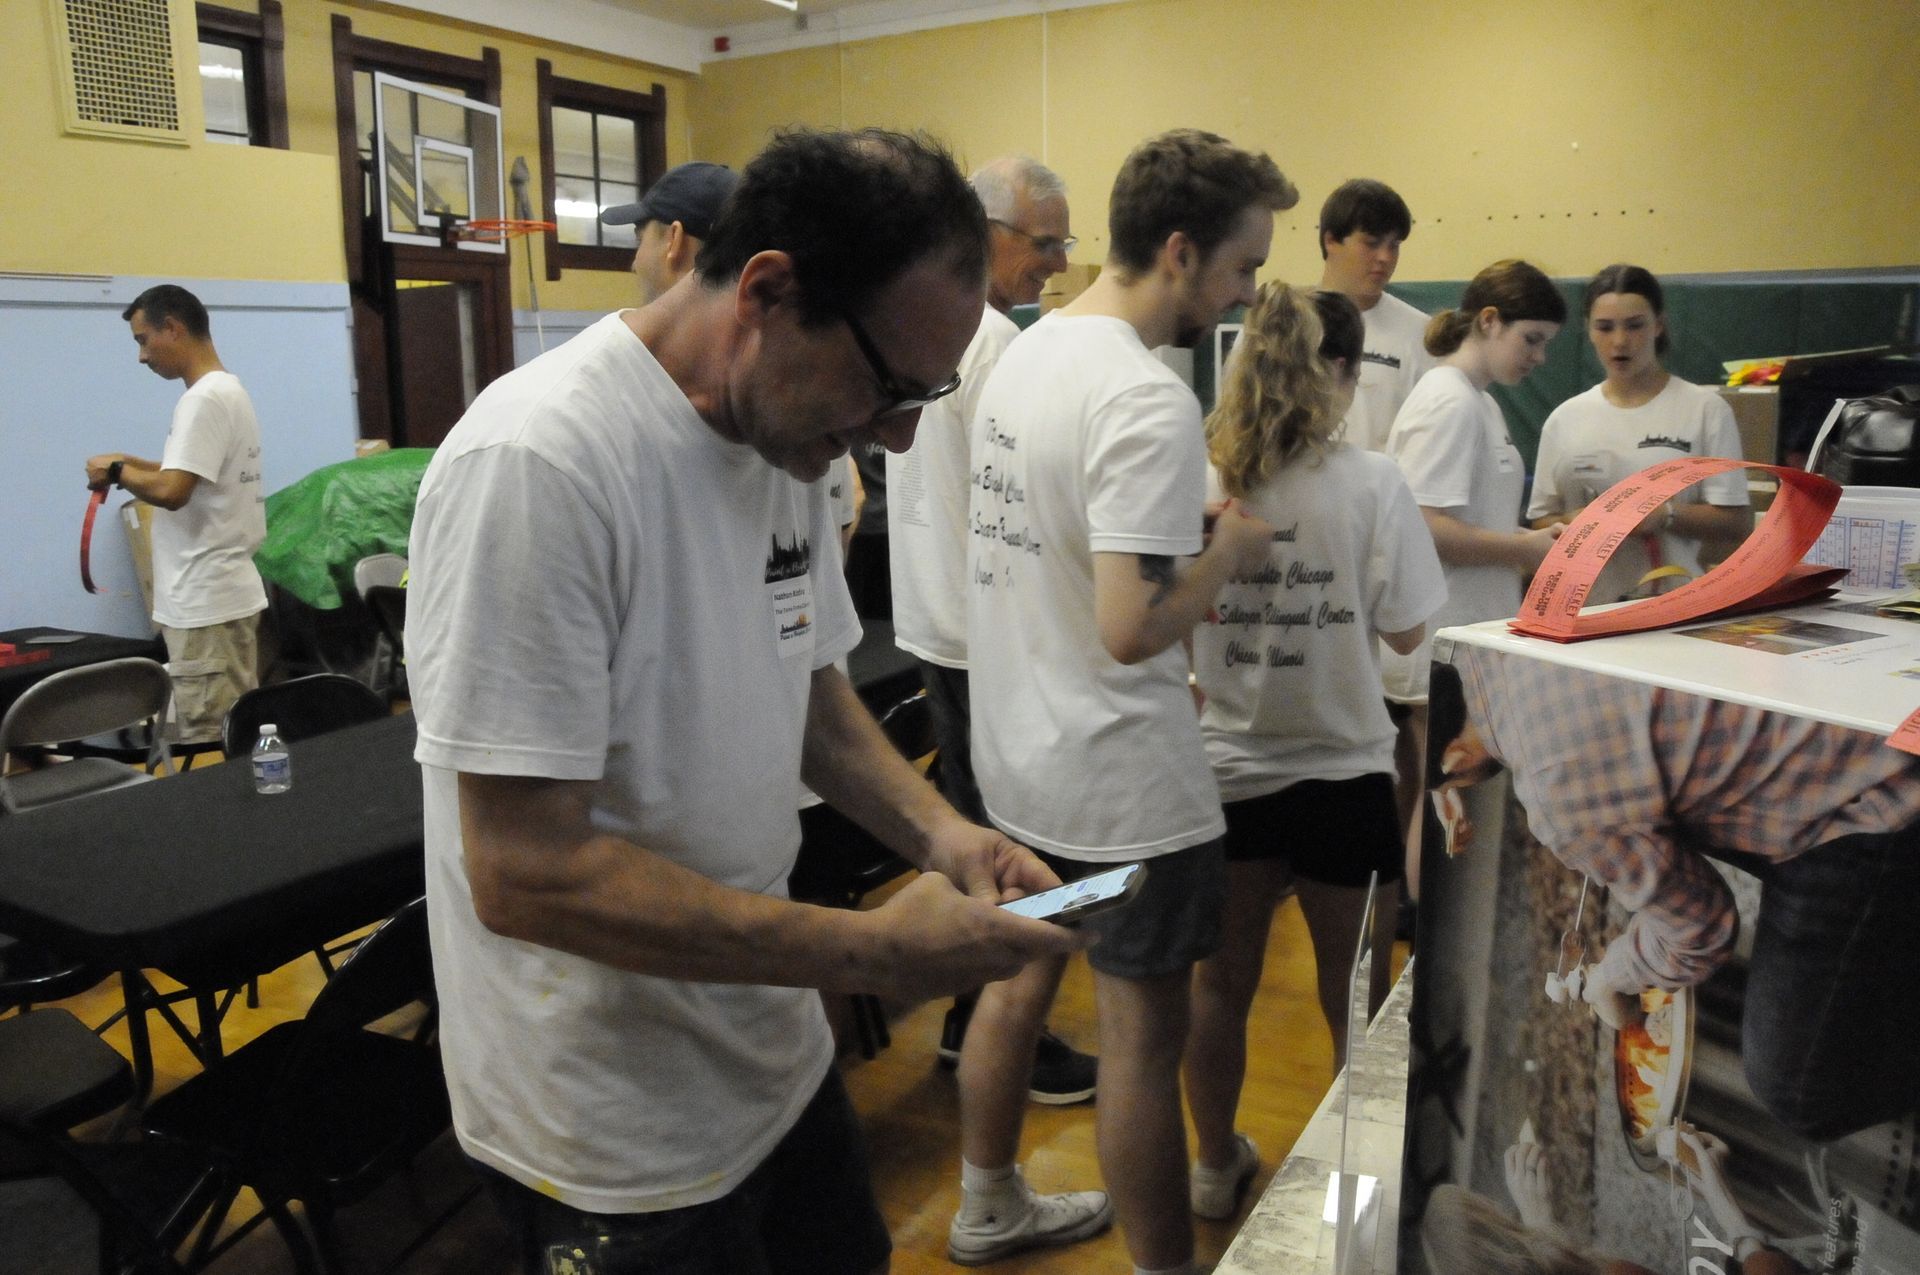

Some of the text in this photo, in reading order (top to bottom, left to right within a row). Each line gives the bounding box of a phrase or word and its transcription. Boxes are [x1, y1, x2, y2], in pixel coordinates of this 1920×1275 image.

[1597, 531, 1625, 560] TICKET
[1286, 561, 1335, 592] Chicago
[1535, 575, 1554, 611] COUPON
[1317, 601, 1355, 630] Center
[1566, 583, 1589, 618] TICKET
[1816, 1197, 1842, 1269] features
[1850, 1214, 1869, 1253] and
